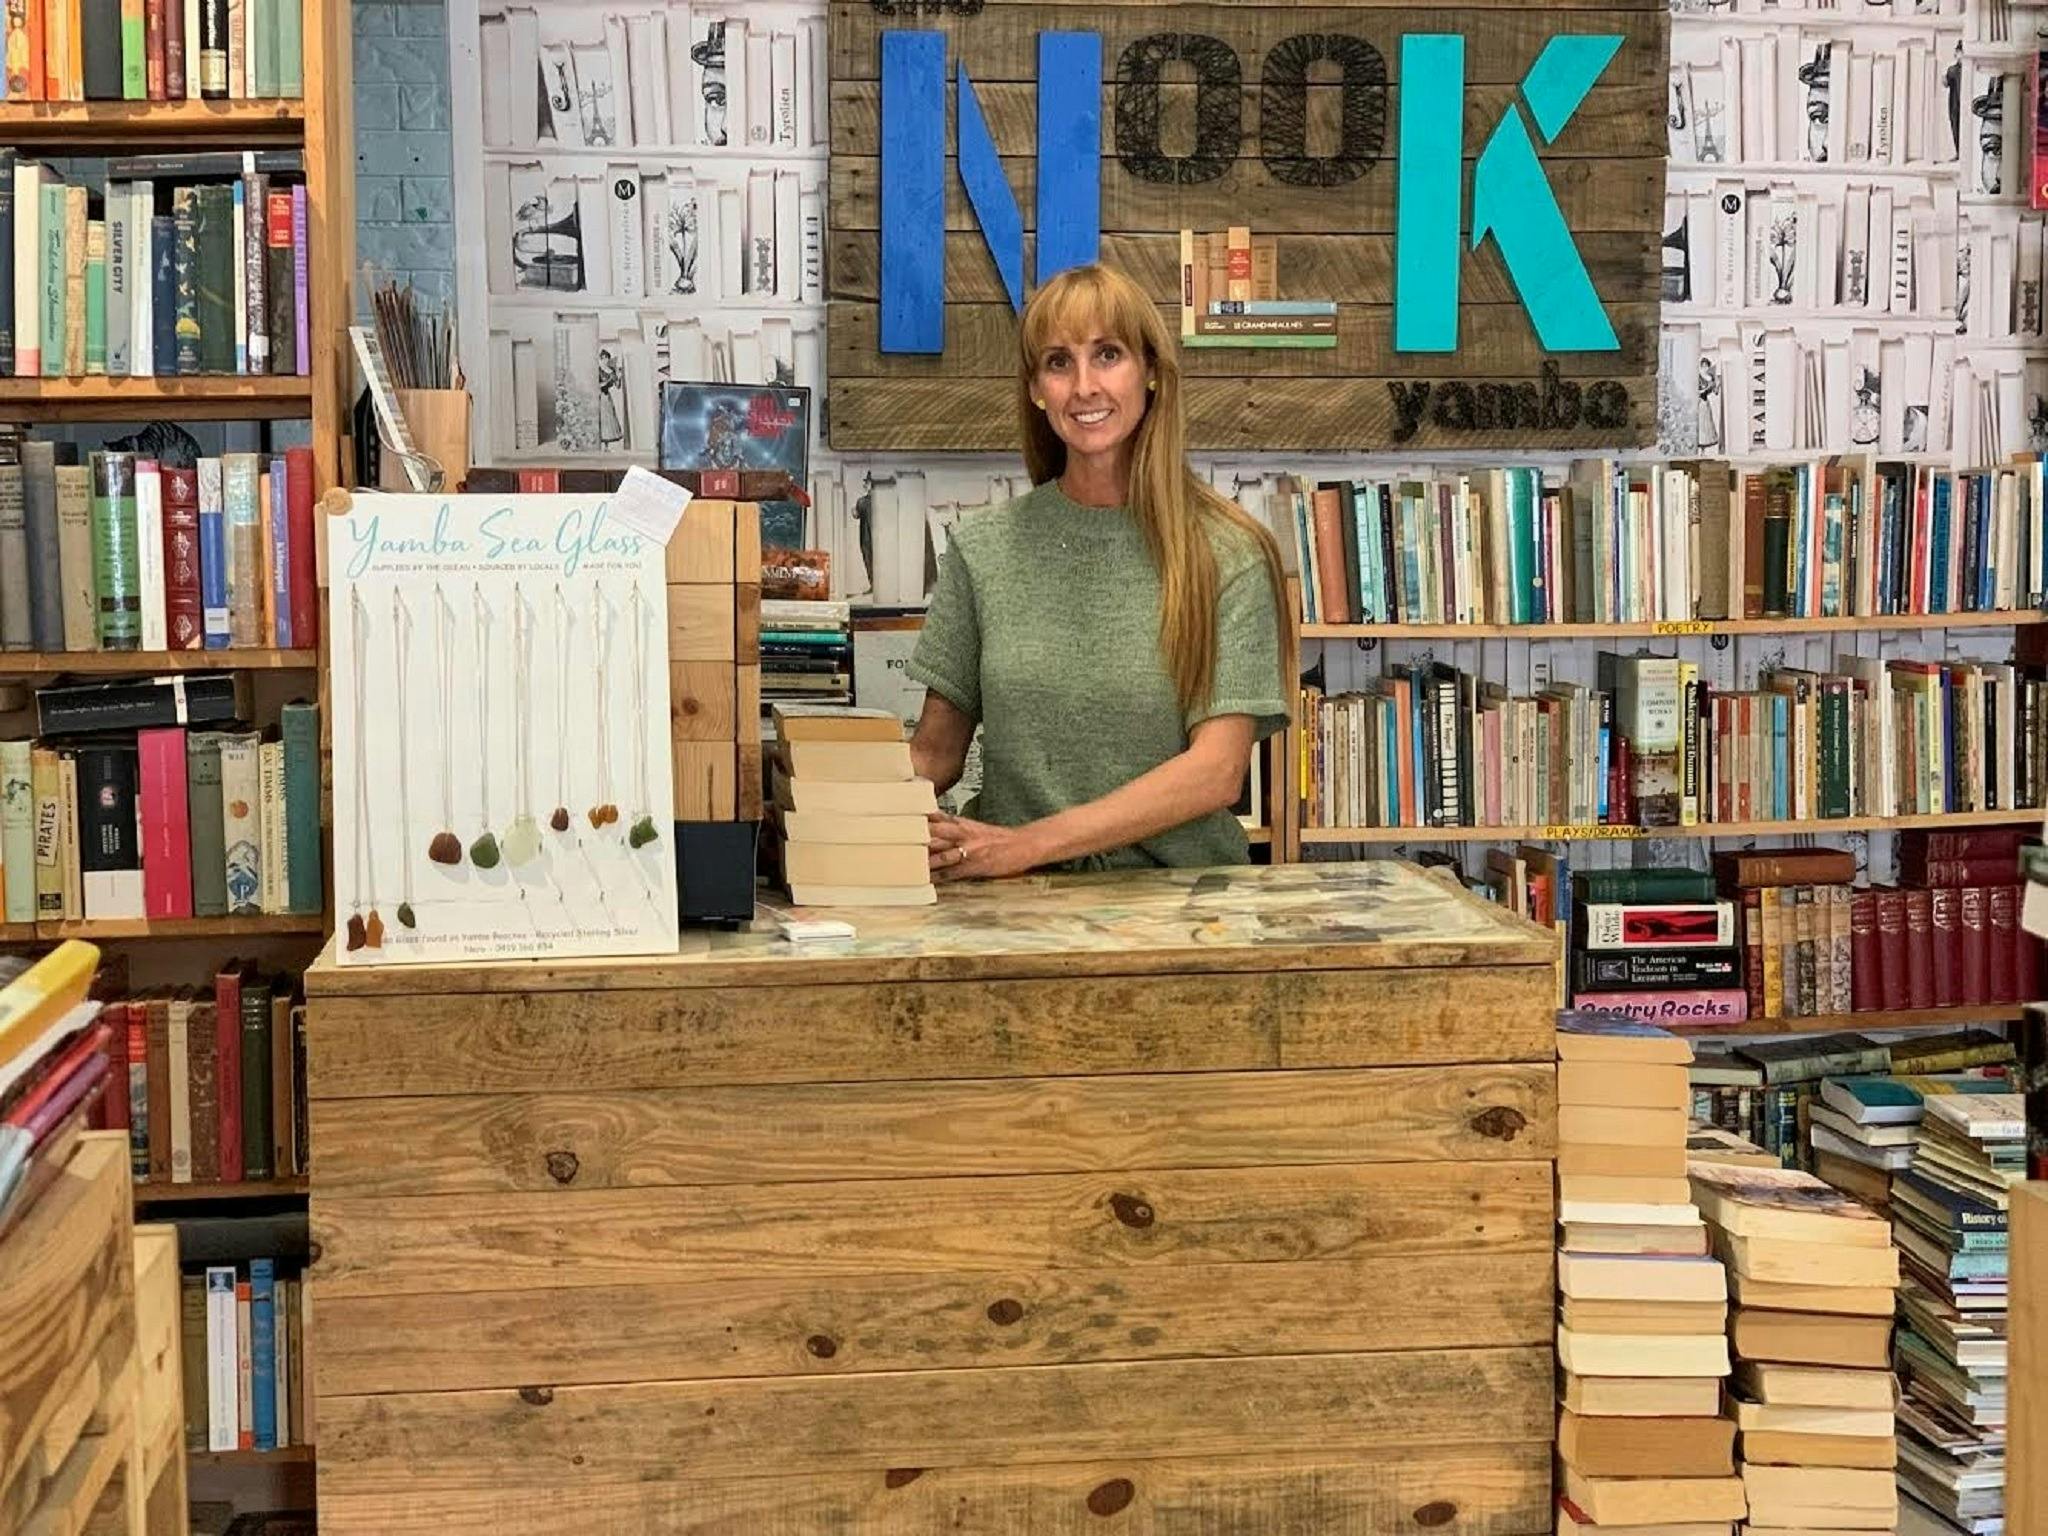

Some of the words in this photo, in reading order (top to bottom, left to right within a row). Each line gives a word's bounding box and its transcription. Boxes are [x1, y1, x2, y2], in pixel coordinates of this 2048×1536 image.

[780, 88, 792, 141] Tyrolien
[1876, 106, 1888, 158] Tyrolien
[112, 220, 123, 264] SILVER
[807, 216, 819, 288] UFFIZI
[112, 266, 123, 293] CITY
[1895, 229, 1908, 300] UFFIZI
[1242, 321, 1267, 330] GRAND
[1387, 359, 1630, 443] yamba
[347, 504, 469, 578] Yamba
[480, 508, 548, 559] Sea
[556, 502, 643, 578] Glass
[1658, 622, 1709, 634] POETRY
[887, 660, 909, 669] FO
[1686, 686, 1697, 744] Shakespeare
[264, 769, 275, 804] TIMMS
[1688, 751, 1697, 794] Dummies
[37, 802, 56, 857] PIRATES
[1547, 827, 1641, 837] PLAYS/DRAMA
[1632, 956, 1647, 964] The
[1649, 955, 1687, 964] American
[1632, 965, 1667, 973] Tradition
[1632, 974, 1669, 983] Literature
[1661, 1000, 1731, 1017] Rocks
[1962, 1213, 1996, 1226] History
